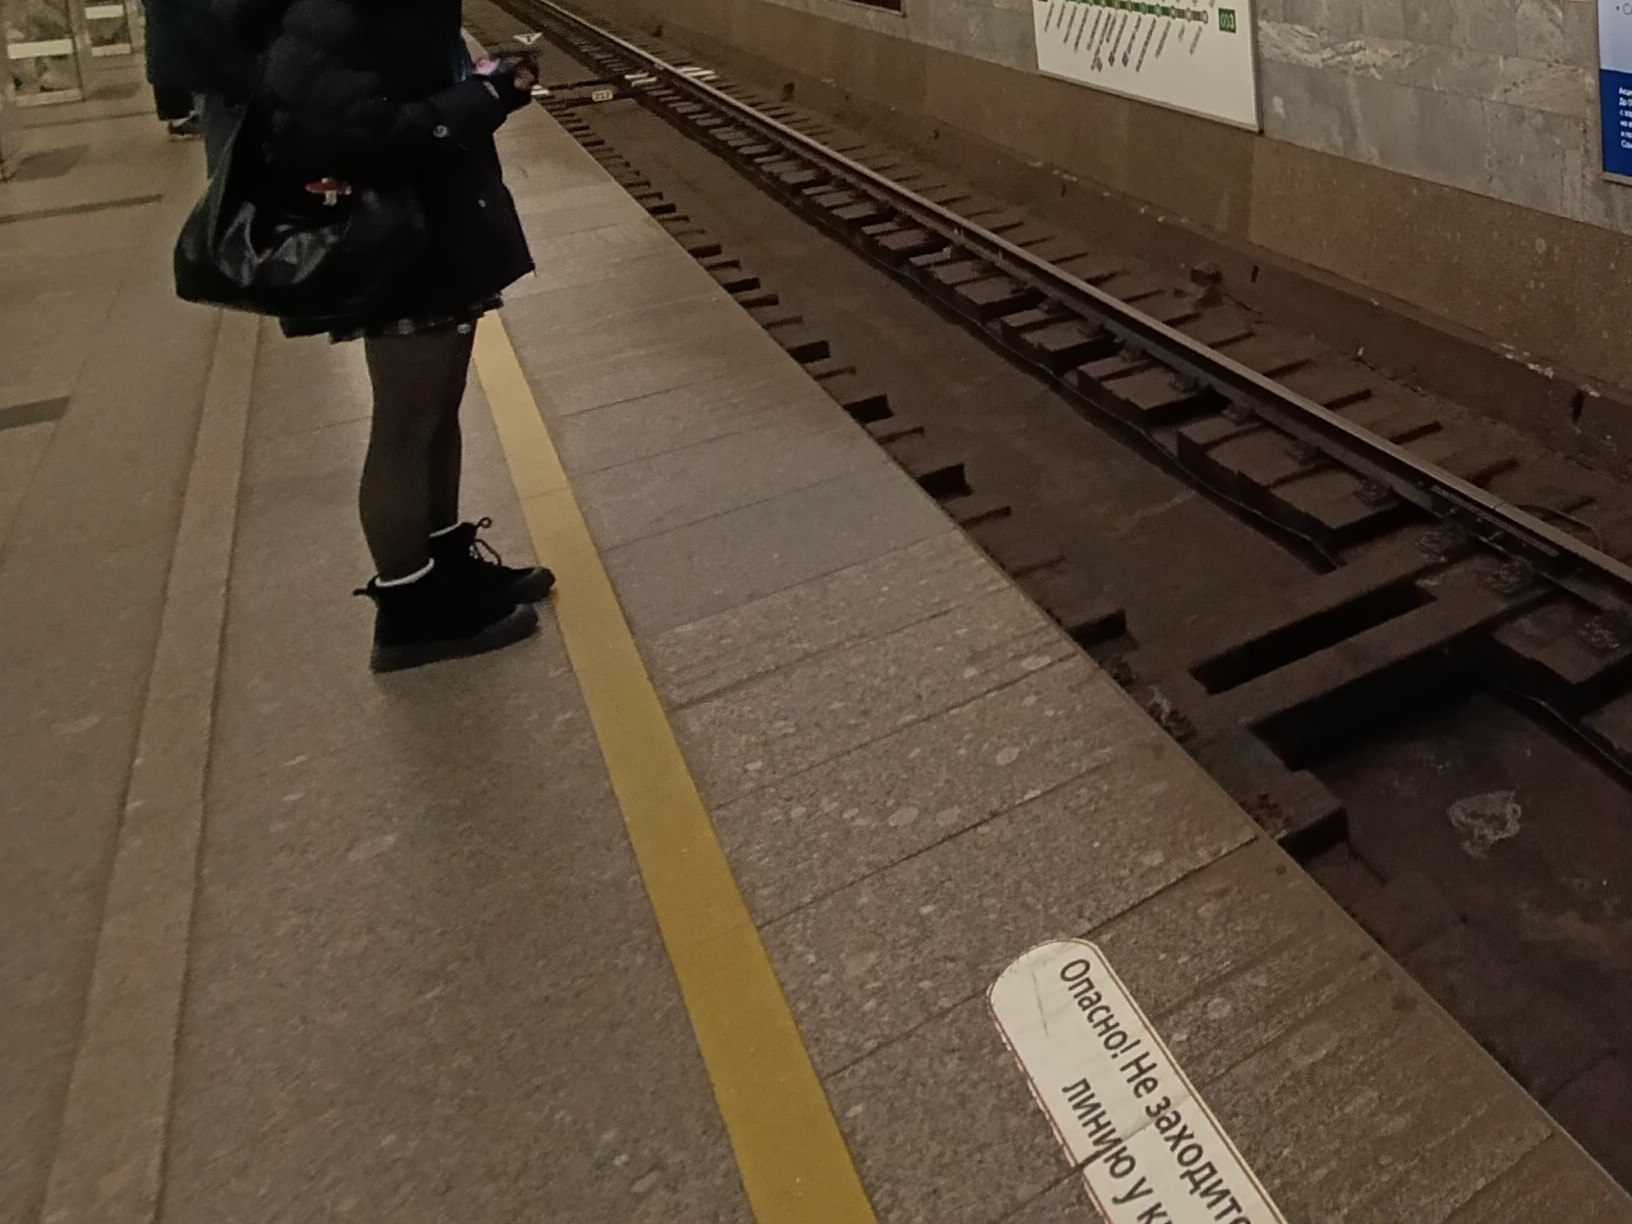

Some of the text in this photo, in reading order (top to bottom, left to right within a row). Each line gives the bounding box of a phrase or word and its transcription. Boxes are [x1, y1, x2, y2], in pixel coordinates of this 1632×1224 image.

[1059, 958, 1141, 1060] Опасно!
[1119, 1051, 1159, 1099] Не
[1062, 1077, 1136, 1180] линию
[1111, 1176, 1154, 1205] у
